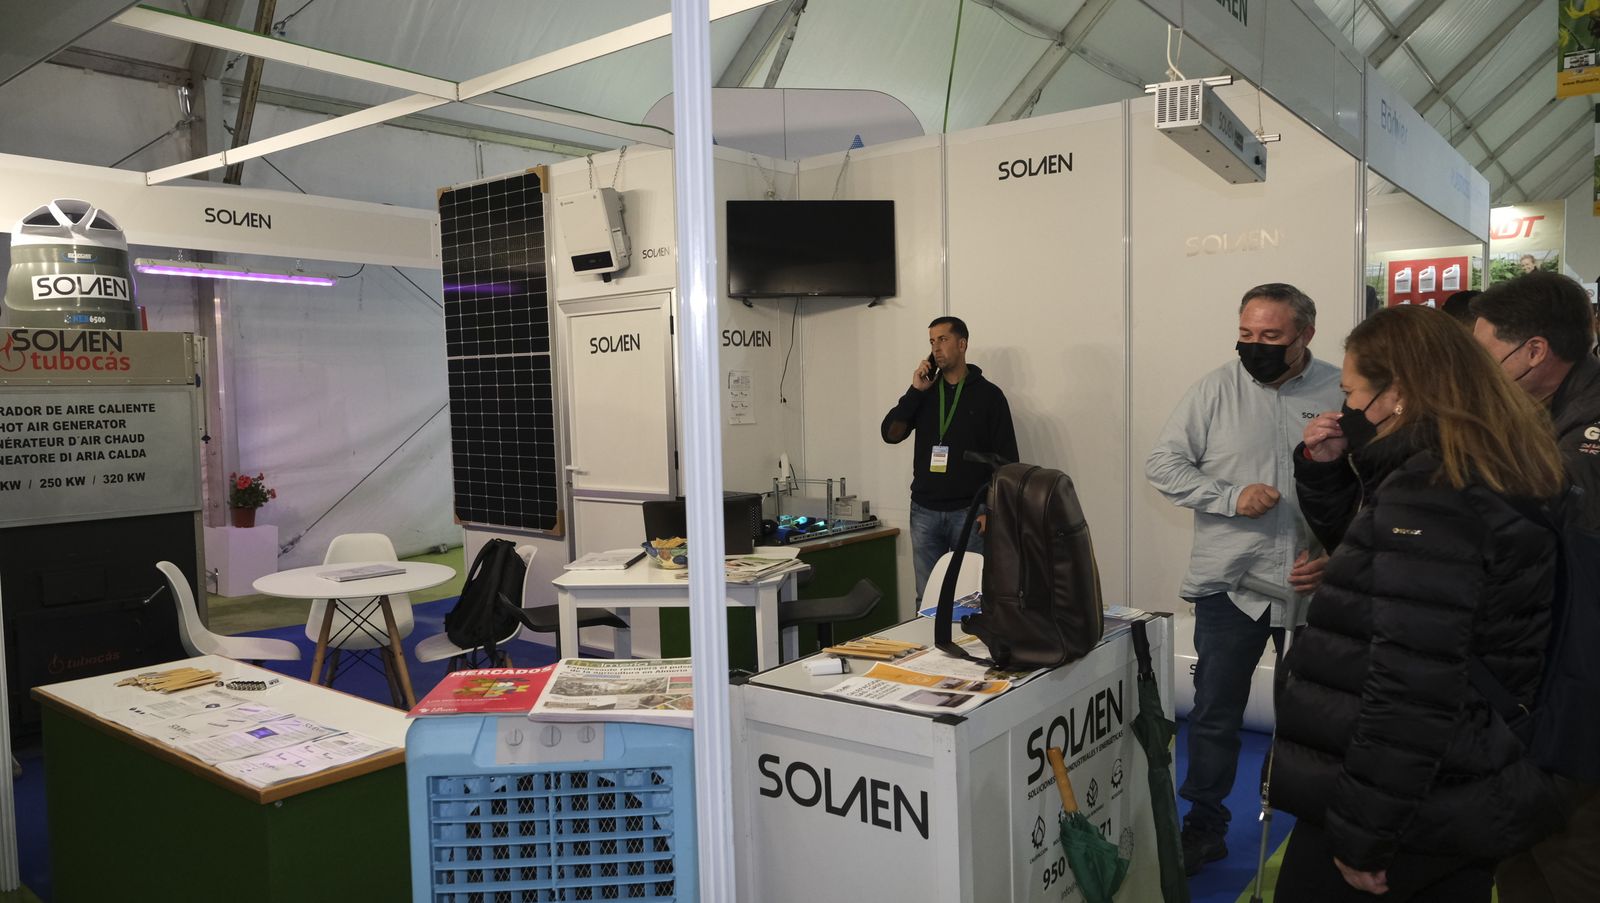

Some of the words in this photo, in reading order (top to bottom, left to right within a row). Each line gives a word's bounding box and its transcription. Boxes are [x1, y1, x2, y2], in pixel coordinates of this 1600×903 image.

[998, 152, 1073, 181] SOLAEN
[204, 207, 272, 230] SOLAEN
[642, 247, 670, 260] SOLAEN
[36, 276, 127, 298] SOLAEN
[11, 329, 123, 353] SOLAEN
[590, 333, 641, 354] SOLAEN
[722, 330, 772, 348] SOLAEN
[31, 351, 131, 371] tubocás
[46, 405, 62, 416] DE
[66, 404, 95, 414] AIRE
[98, 403, 156, 414] CALIENTE
[27, 421, 49, 432] AIR
[53, 419, 127, 431] GENERATOR
[104, 433, 145, 445] CHAUD
[60, 452, 72, 463] DI
[76, 451, 105, 462] ARIA
[108, 449, 147, 460] CALDA
[0, 480, 21, 491] KW
[40, 477, 62, 489] 250
[65, 476, 86, 487] KW
[103, 473, 124, 484] 320
[127, 472, 146, 482] KW
[451, 665, 554, 678] MERCADOS
[1026, 680, 1123, 785] SOLAEN
[757, 753, 929, 841] SOLAEN
[1043, 856, 1065, 891] 950
